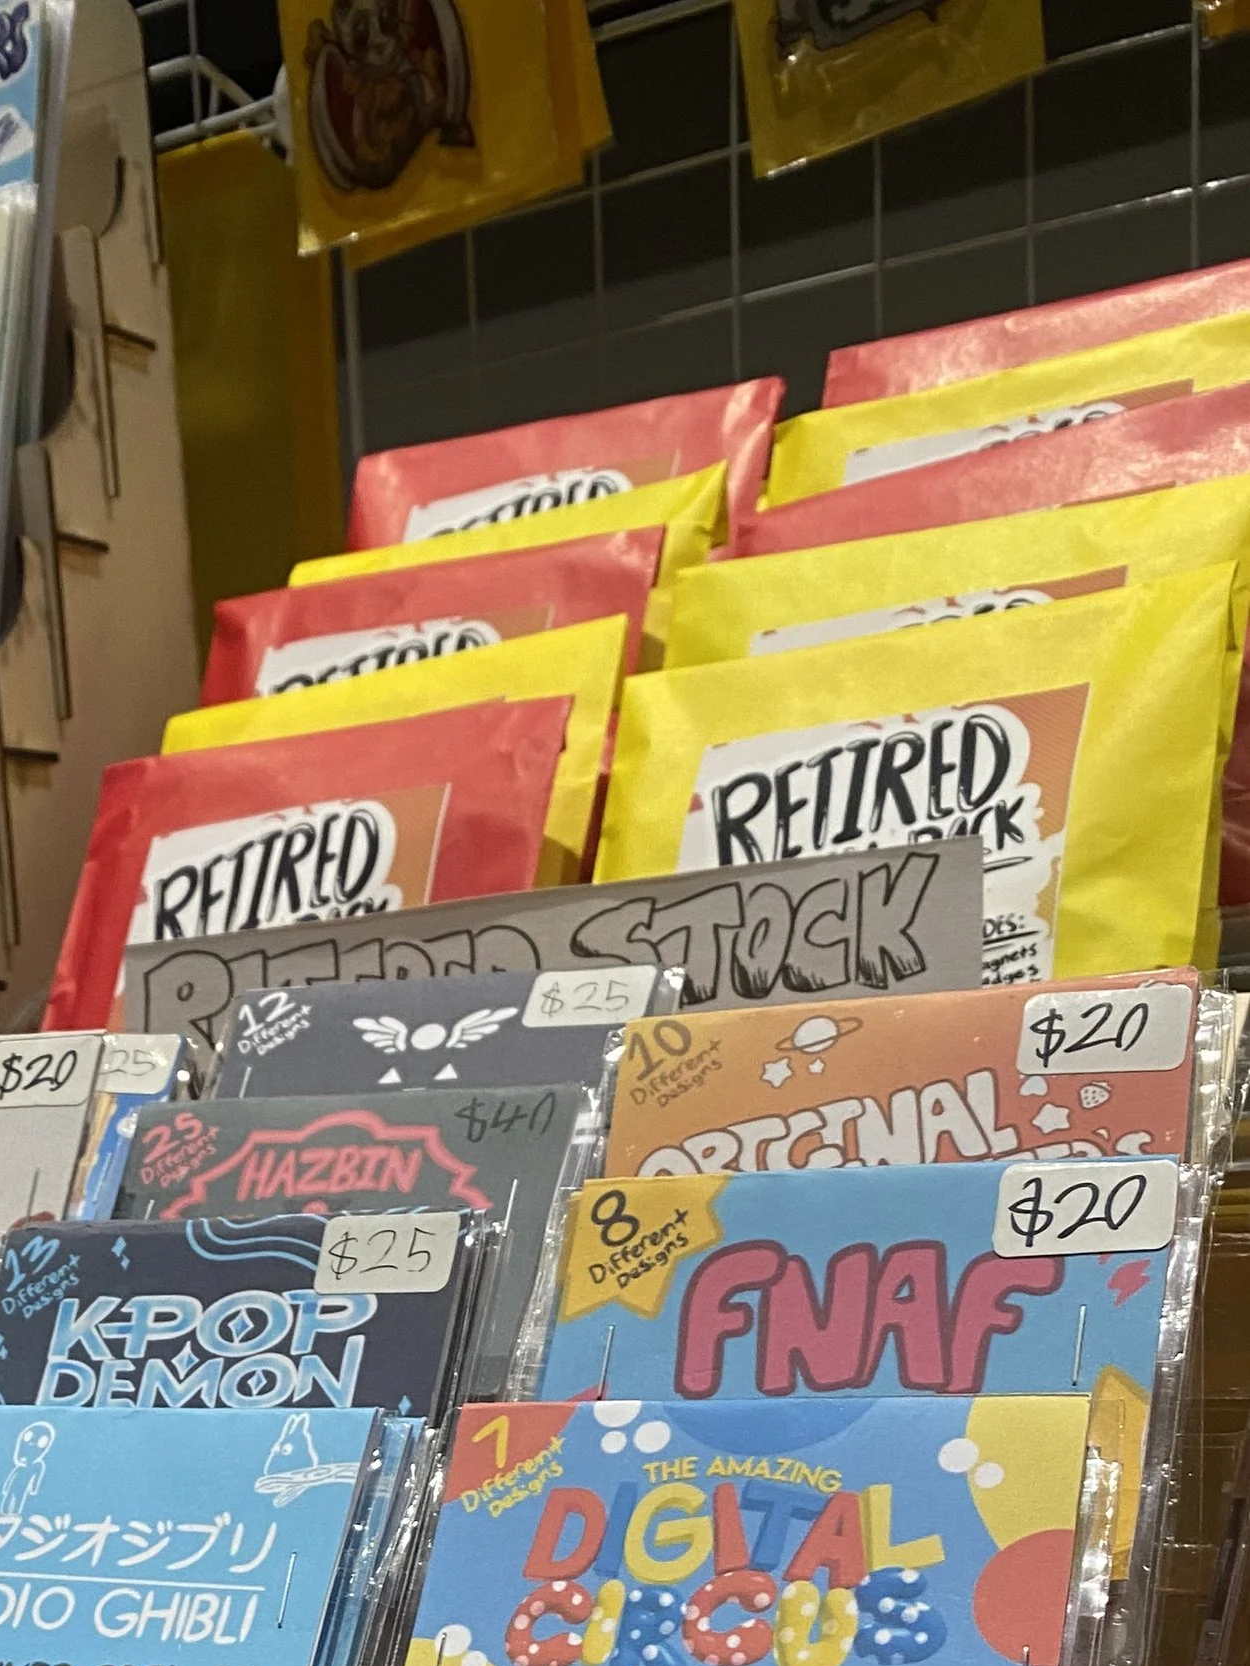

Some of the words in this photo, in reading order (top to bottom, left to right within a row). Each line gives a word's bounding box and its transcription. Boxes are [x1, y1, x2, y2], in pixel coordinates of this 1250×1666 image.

[711, 712, 1012, 868] RETIRED
[154, 808, 380, 942] RETIRED
[570, 852, 939, 1006] STOCK
[237, 991, 296, 1038] 12
[540, 980, 630, 1017] $25
[628, 1018, 692, 1081] 10
[1029, 1001, 1149, 1068] $20
[141, 1111, 203, 1166] 25
[236, 1144, 424, 1202] HAZBIN
[590, 1188, 641, 1248] 8
[1008, 1172, 1148, 1248] $20
[3, 1235, 61, 1293] 13
[326, 1228, 442, 1281] $25
[673, 1238, 1066, 1399] FNAF
[35, 1334, 367, 1408] DEMON
[643, 1458, 700, 1483] THE
[705, 1455, 844, 1495] AMAZING
[521, 1481, 946, 1590] DIGITAL
[93, 1585, 260, 1645] GHIBLI
